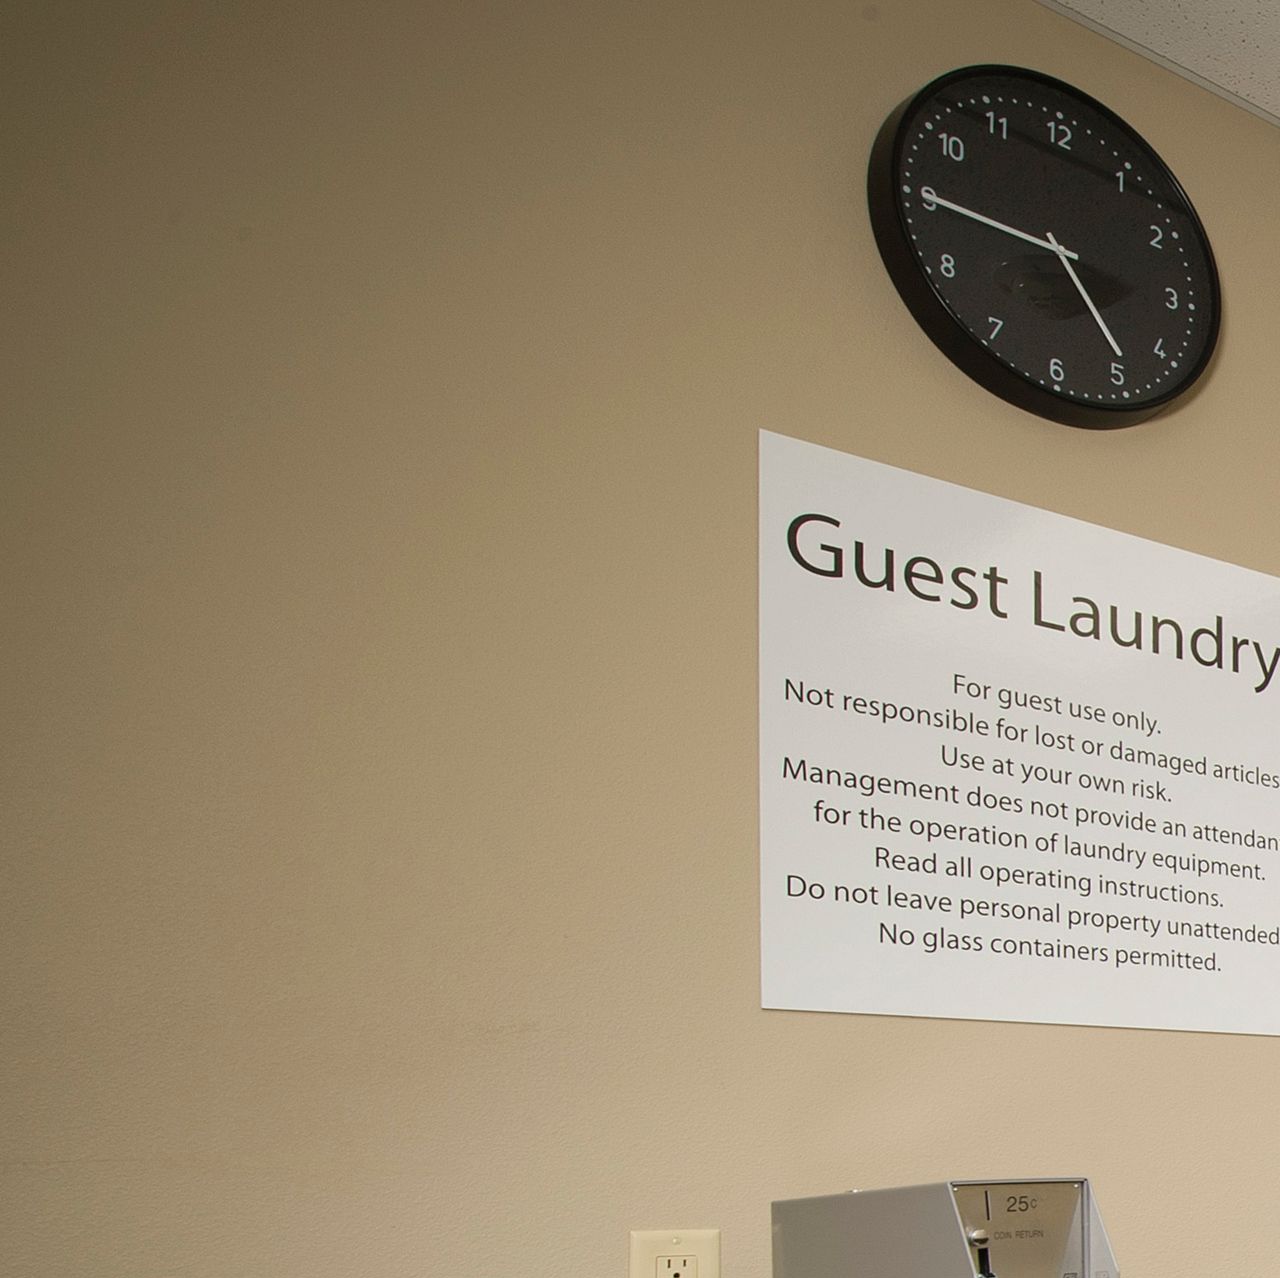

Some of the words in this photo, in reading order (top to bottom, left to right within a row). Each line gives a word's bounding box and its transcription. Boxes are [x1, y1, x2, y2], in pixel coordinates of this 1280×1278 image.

[986, 112, 1007, 140] 11
[1047, 122, 1072, 150] 12
[938, 133, 964, 161] 10
[1115, 171, 1124, 192] 1
[921, 186, 937, 211] 9
[1150, 225, 1162, 248] 2
[940, 254, 955, 278] 8
[1165, 287, 1178, 309] 3
[988, 316, 1003, 339] 7
[1153, 338, 1166, 359] 4
[1050, 358, 1064, 381] 6
[1111, 363, 1124, 385] 5
[786, 513, 1007, 618] Guest
[954, 673, 991, 699] For
[998, 688, 1061, 714] guest
[1069, 702, 1105, 722] use
[1112, 711, 1160, 737] only.
[785, 678, 833, 708] Not
[843, 695, 988, 735] responsible
[996, 717, 1028, 742] for
[1035, 724, 1074, 751] lost
[1081, 740, 1103, 755] or
[1110, 740, 1206, 775] damaged
[941, 744, 984, 771] Use
[992, 758, 1014, 776] at
[1021, 763, 1072, 784] your
[1078, 774, 1124, 794] own
[1132, 779, 1171, 801] risk.
[783, 756, 958, 803] Management
[966, 785, 1022, 812] does
[1031, 800, 1068, 820] not
[1075, 807, 1156, 832] provide
[1162, 821, 1185, 837] an
[813, 799, 851, 825] for
[858, 807, 901, 832] the
[909, 819, 1026, 848] operation
[1035, 832, 1058, 852] of
[1064, 834, 1145, 869] laundry
[1152, 853, 1264, 880] equipment.
[875, 846, 936, 873] Read
[945, 856, 971, 877] all
[979, 865, 1090, 896] operating
[1099, 874, 1222, 907] instructions.
[787, 874, 824, 899] Do
[834, 885, 878, 905] not
[887, 884, 951, 912] leave
[960, 899, 1059, 922] personal
[1068, 910, 1160, 937] property
[879, 922, 914, 945] No
[922, 927, 982, 953] glass
[990, 938, 1108, 961] containers
[1116, 949, 1220, 971] permitted.
